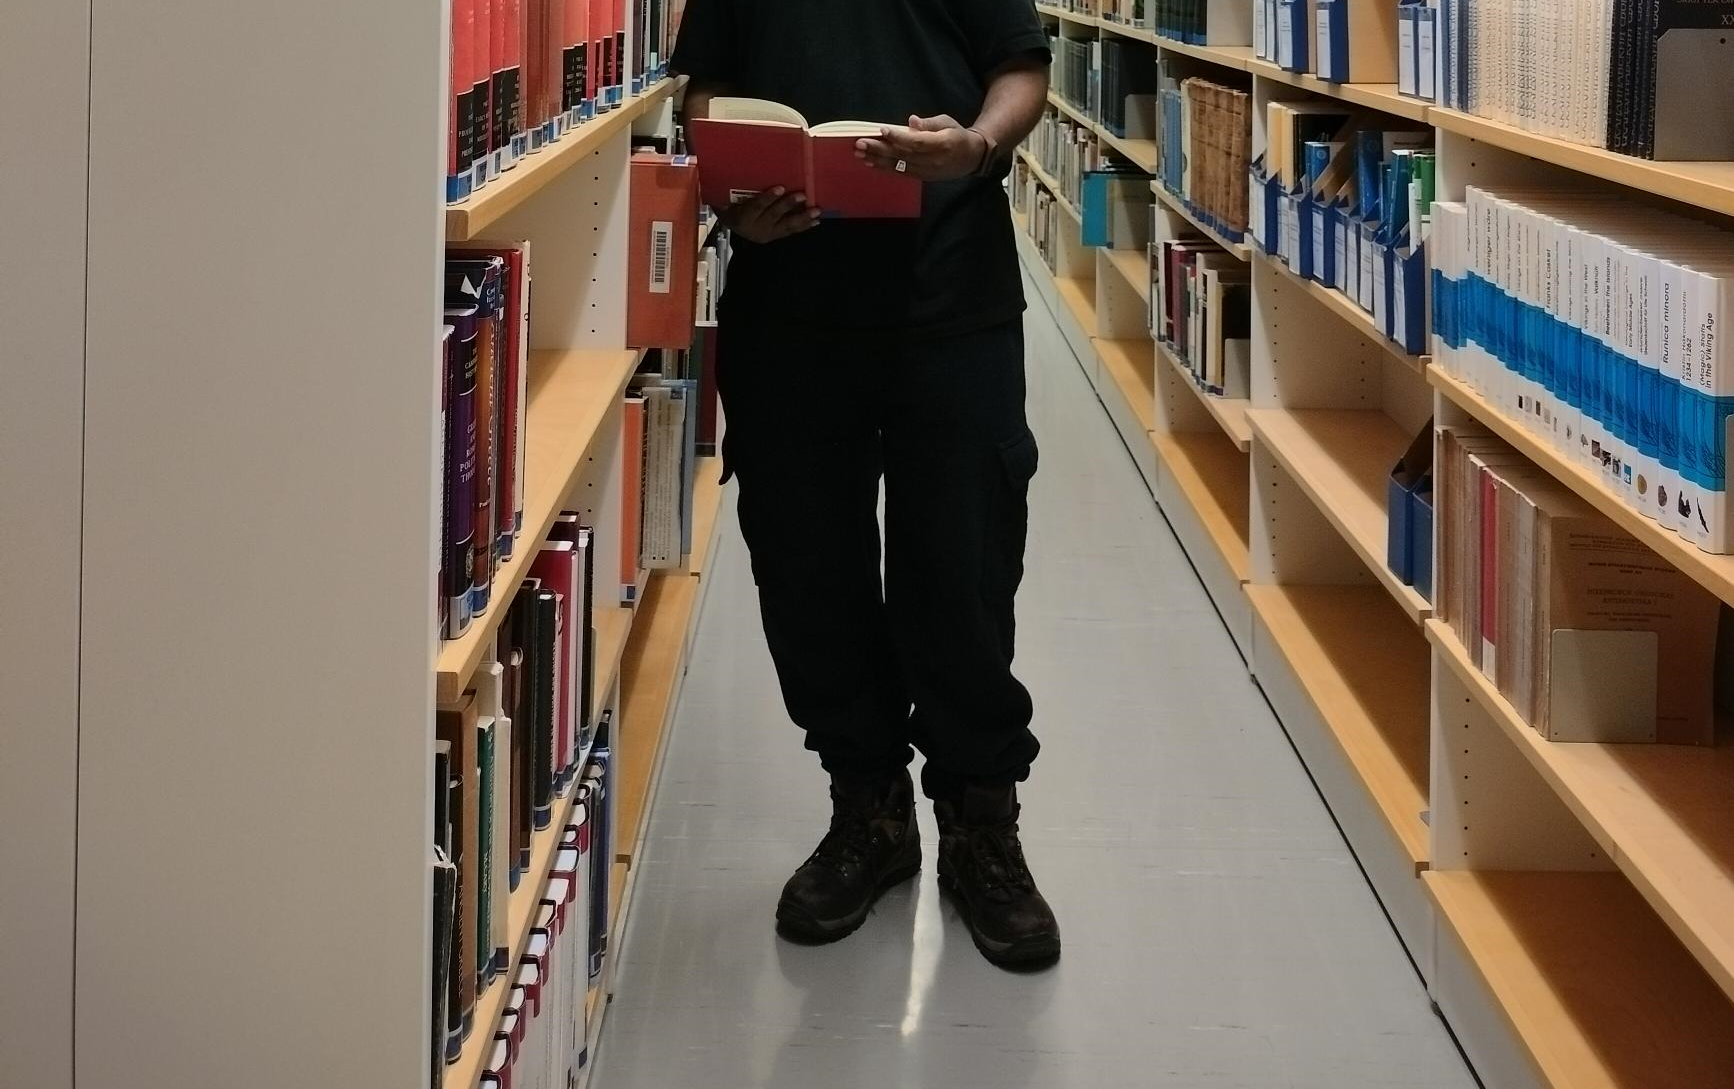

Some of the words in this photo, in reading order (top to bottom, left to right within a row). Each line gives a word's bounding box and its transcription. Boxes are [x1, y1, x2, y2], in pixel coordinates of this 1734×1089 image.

[1706, 313, 1714, 331] Age
[1662, 325, 1670, 364] Runica
[1706, 333, 1714, 360] Viking
[1705, 381, 1711, 389] in
